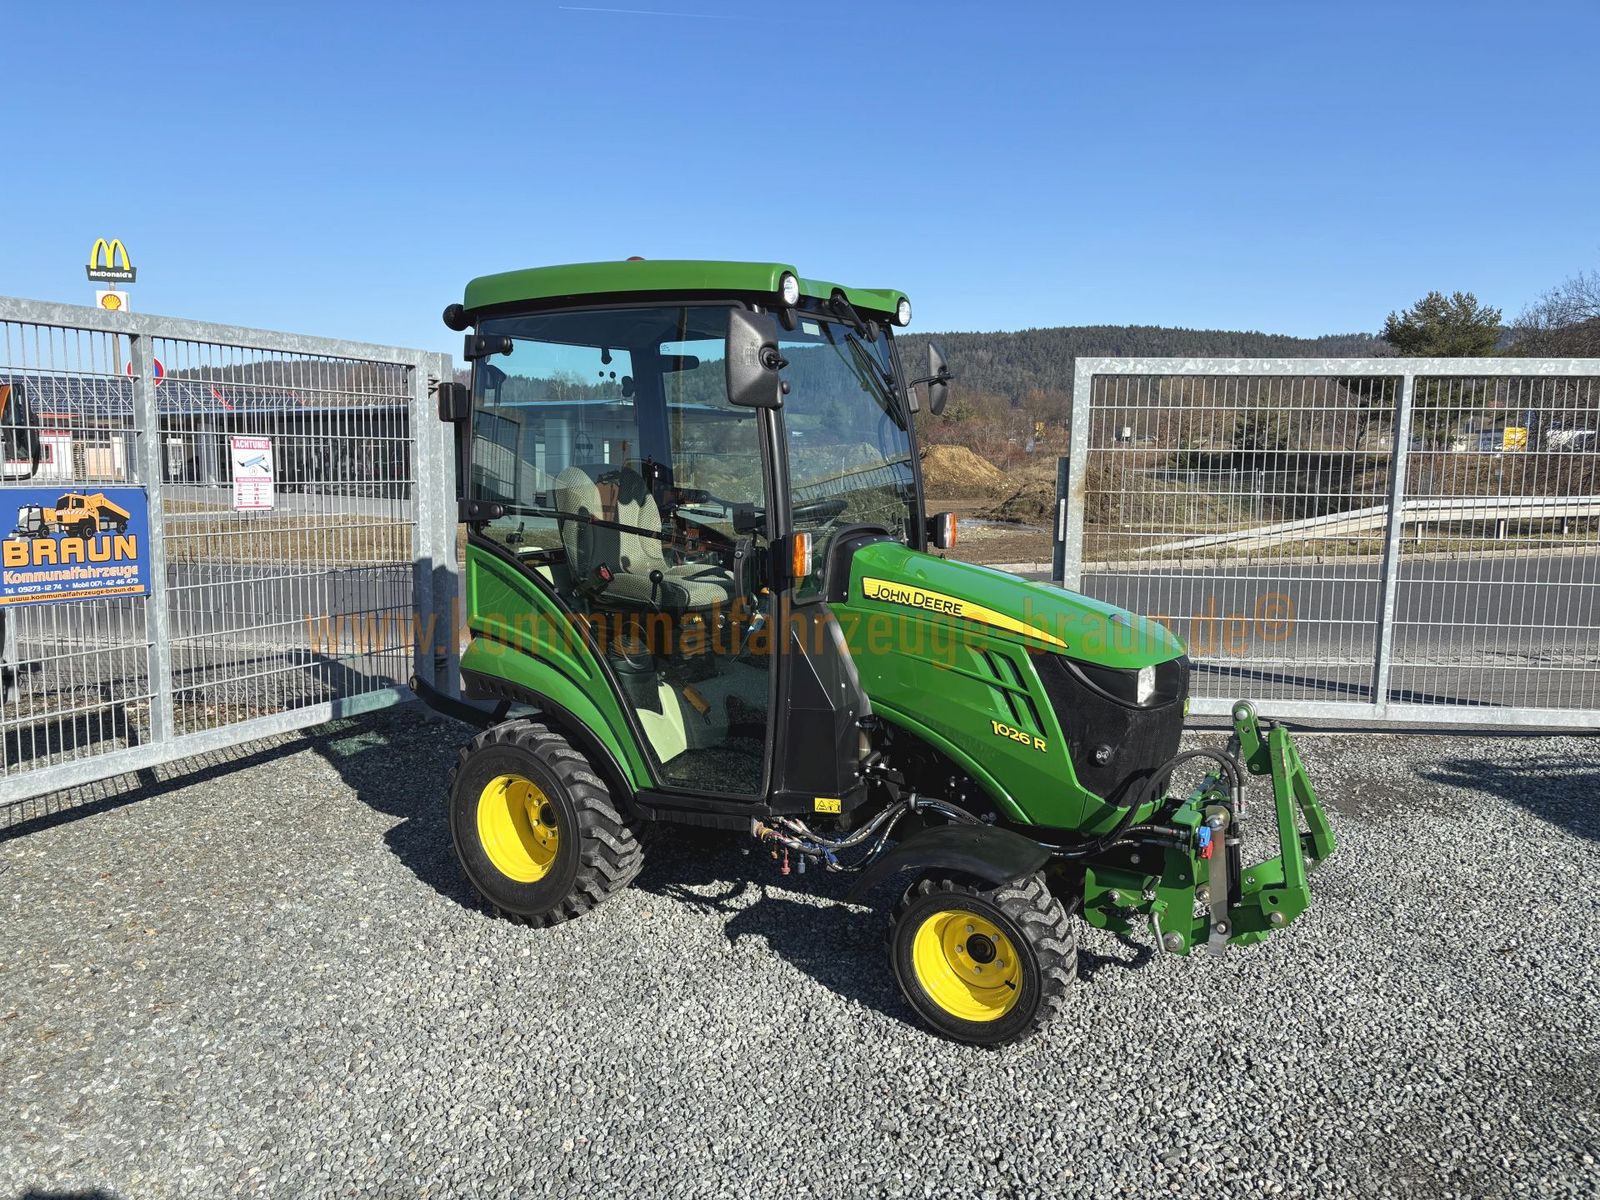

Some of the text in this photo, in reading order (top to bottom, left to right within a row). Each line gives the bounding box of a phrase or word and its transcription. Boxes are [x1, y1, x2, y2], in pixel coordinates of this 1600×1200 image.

[235, 440, 269, 449] ACHTUNG!
[2, 535, 137, 568] BRAUN
[3, 565, 139, 584] Kommunalfahrzeuge
[9, 586, 136, 603] www.kommunalfahrzeuge-braun.de
[72, 581, 90, 589] Mobil
[872, 584, 963, 615] JOHN DEERE
[991, 720, 1047, 753] 1026 R
